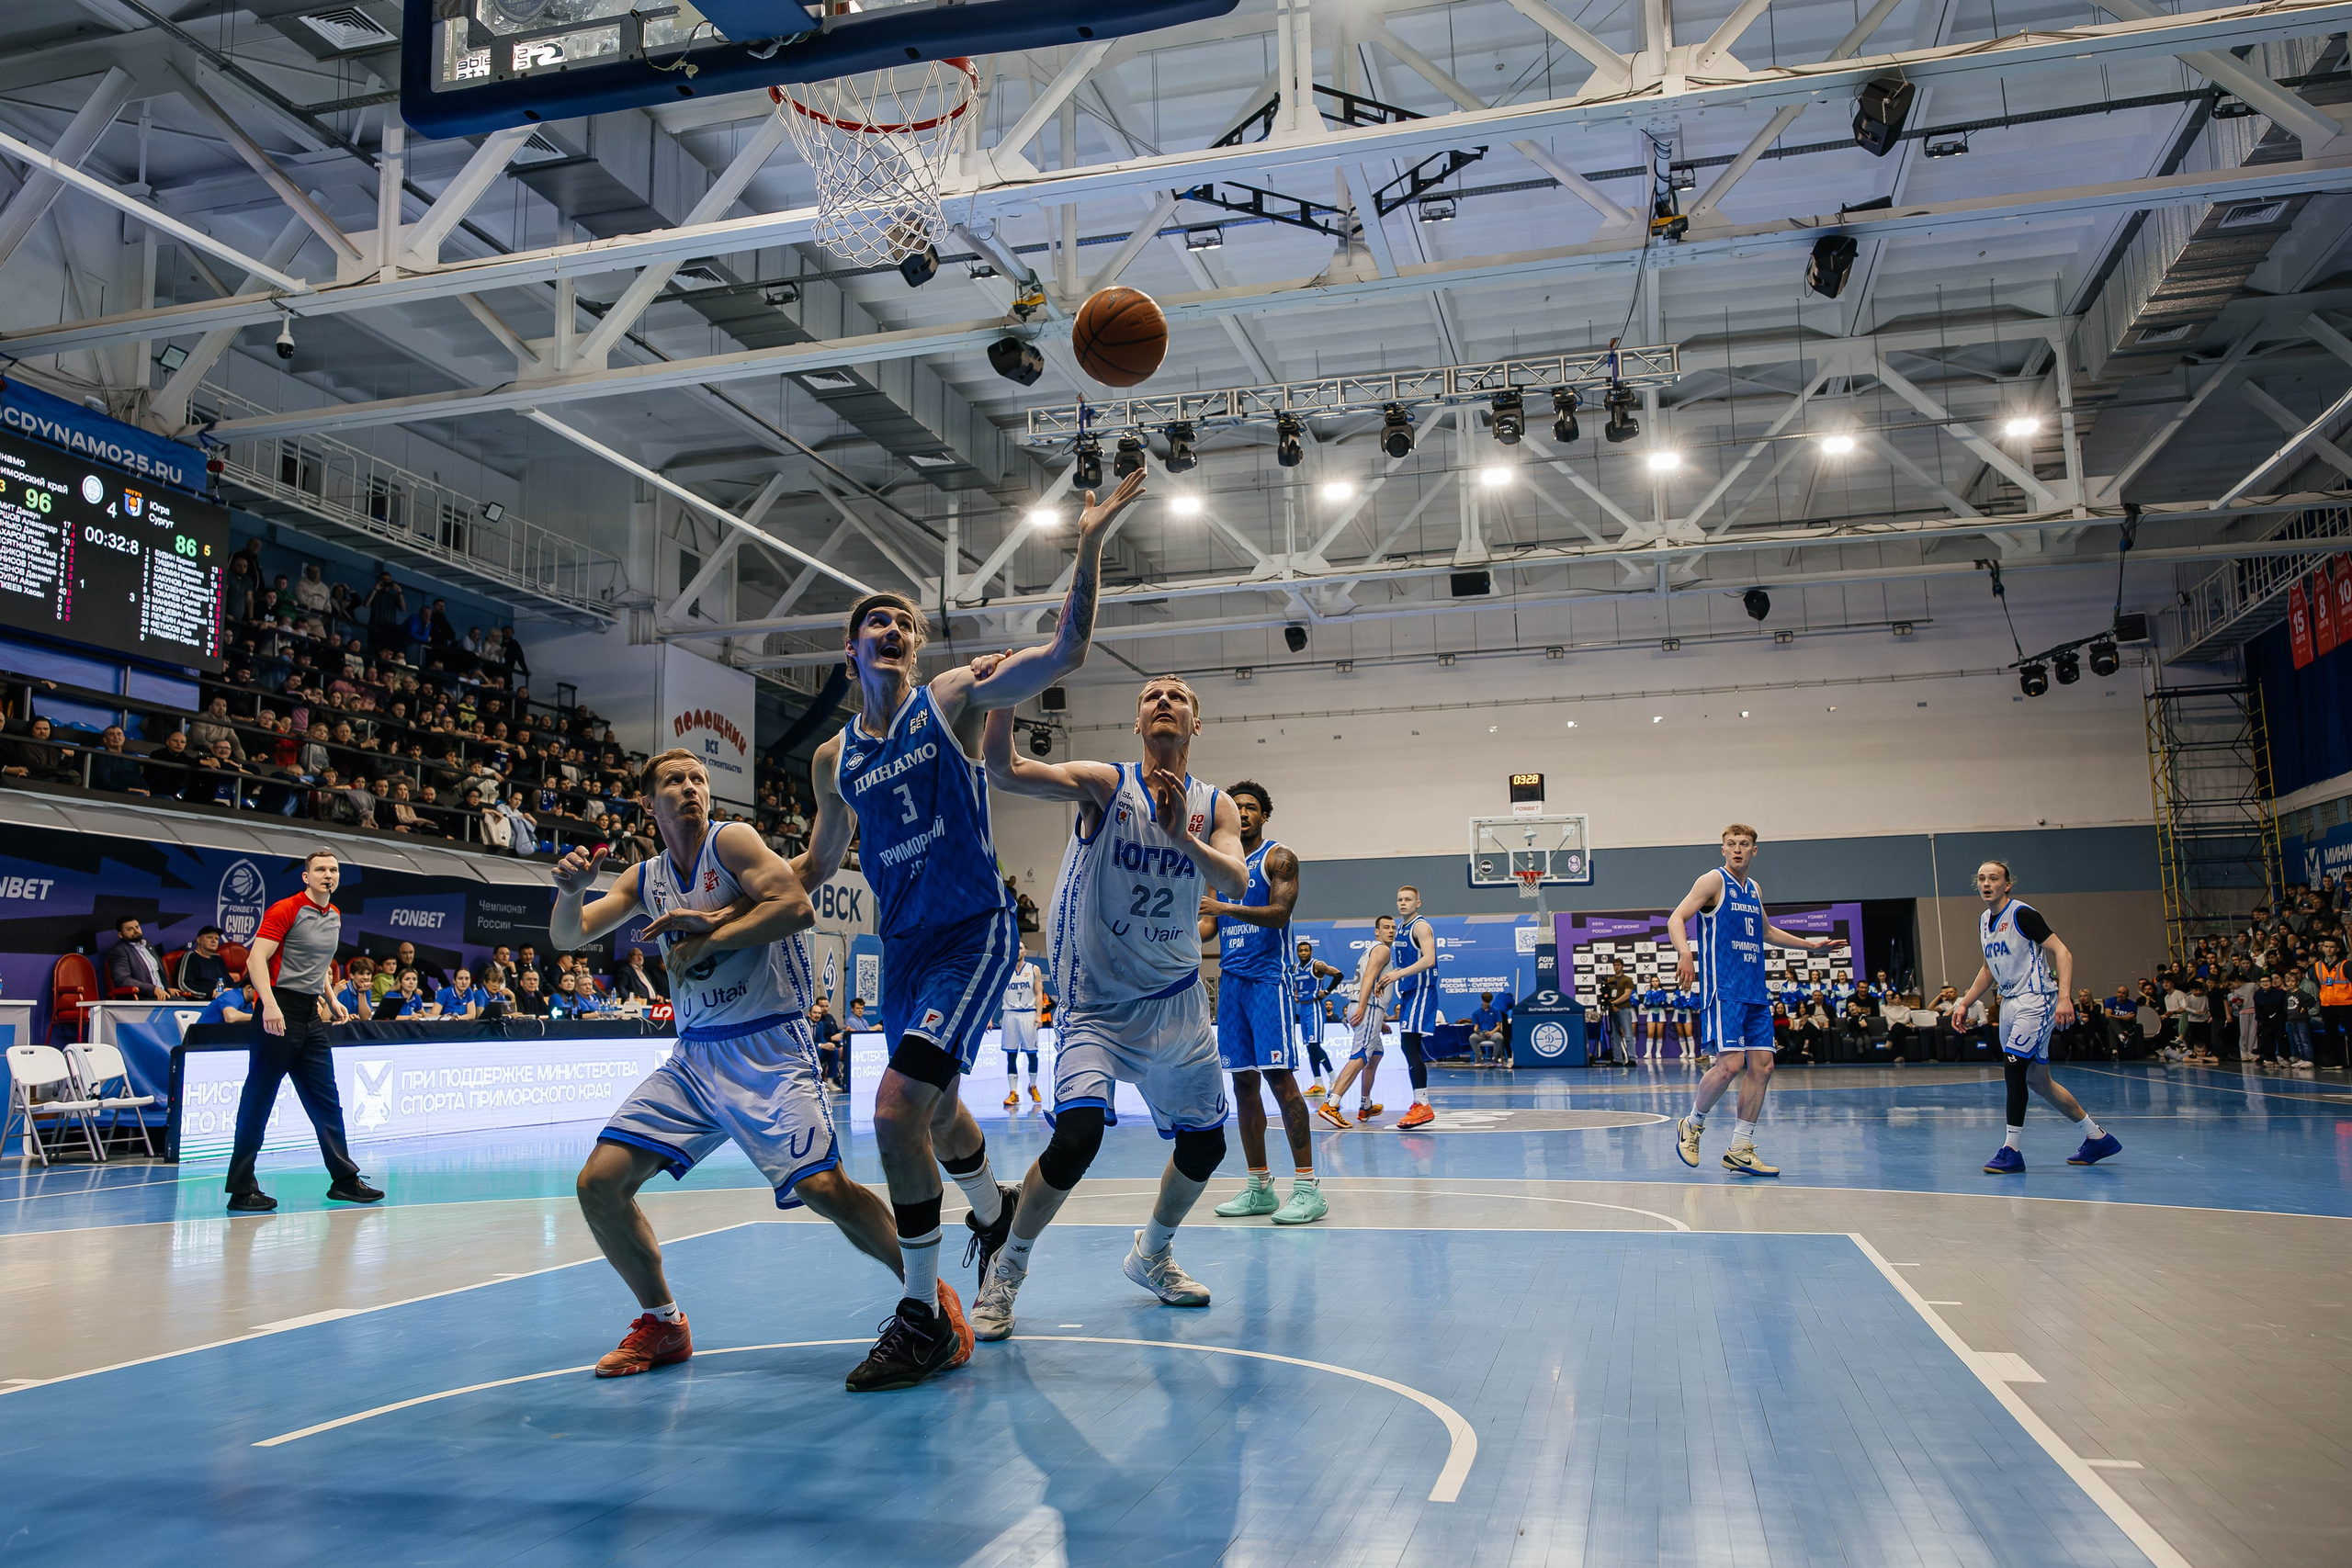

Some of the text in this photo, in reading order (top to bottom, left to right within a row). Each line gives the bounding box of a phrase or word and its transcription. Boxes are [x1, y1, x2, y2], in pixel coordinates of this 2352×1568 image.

[0, 451, 26, 468] намо
[0, 466, 69, 495] иморский край
[25, 488, 52, 513] 96
[149, 501, 171, 516] Югра
[107, 502, 118, 519] 4
[148, 513, 175, 529] Сургут
[0, 528, 27, 542] ХАРОВ
[85, 525, 140, 555] 00:32:8
[0, 536, 41, 555] СЯТНИКОВ
[175, 535, 198, 557] 86
[203, 544, 211, 557] 5
[79, 579, 85, 589] 1
[2338, 578, 2352, 605] 10
[129, 592, 136, 603] 3
[2319, 594, 2326, 619] 8
[2293, 609, 2304, 635] 15
[673, 707, 747, 756] ПОМОЩНИК
[910, 716, 928, 735] BET
[854, 743, 937, 796] ДИНАМО
[893, 783, 918, 824] 3
[1188, 823, 1204, 832] BE
[1191, 814, 1204, 823] FO
[1112, 836, 1194, 879] ЮГРА
[229, 905, 254, 913] FONBET
[479, 899, 526, 914] Чемпионат
[822, 884, 863, 922] ВСК
[1129, 884, 1174, 918] 22
[225, 915, 254, 934] СУПЕР
[390, 908, 446, 929] FONBET
[478, 917, 511, 930] России
[1745, 917, 1755, 937] 16
[702, 979, 749, 1008] Utair
[1017, 992, 1023, 1001] 7
[401, 1060, 639, 1091] ПРИ ПОДДЕРЖКЕ МИНИСТЕРСТВА
[400, 1082, 613, 1116] СПОРТА ПРИМОРСКОГО КРАЯ
[1060, 1084, 1074, 1095] STK
